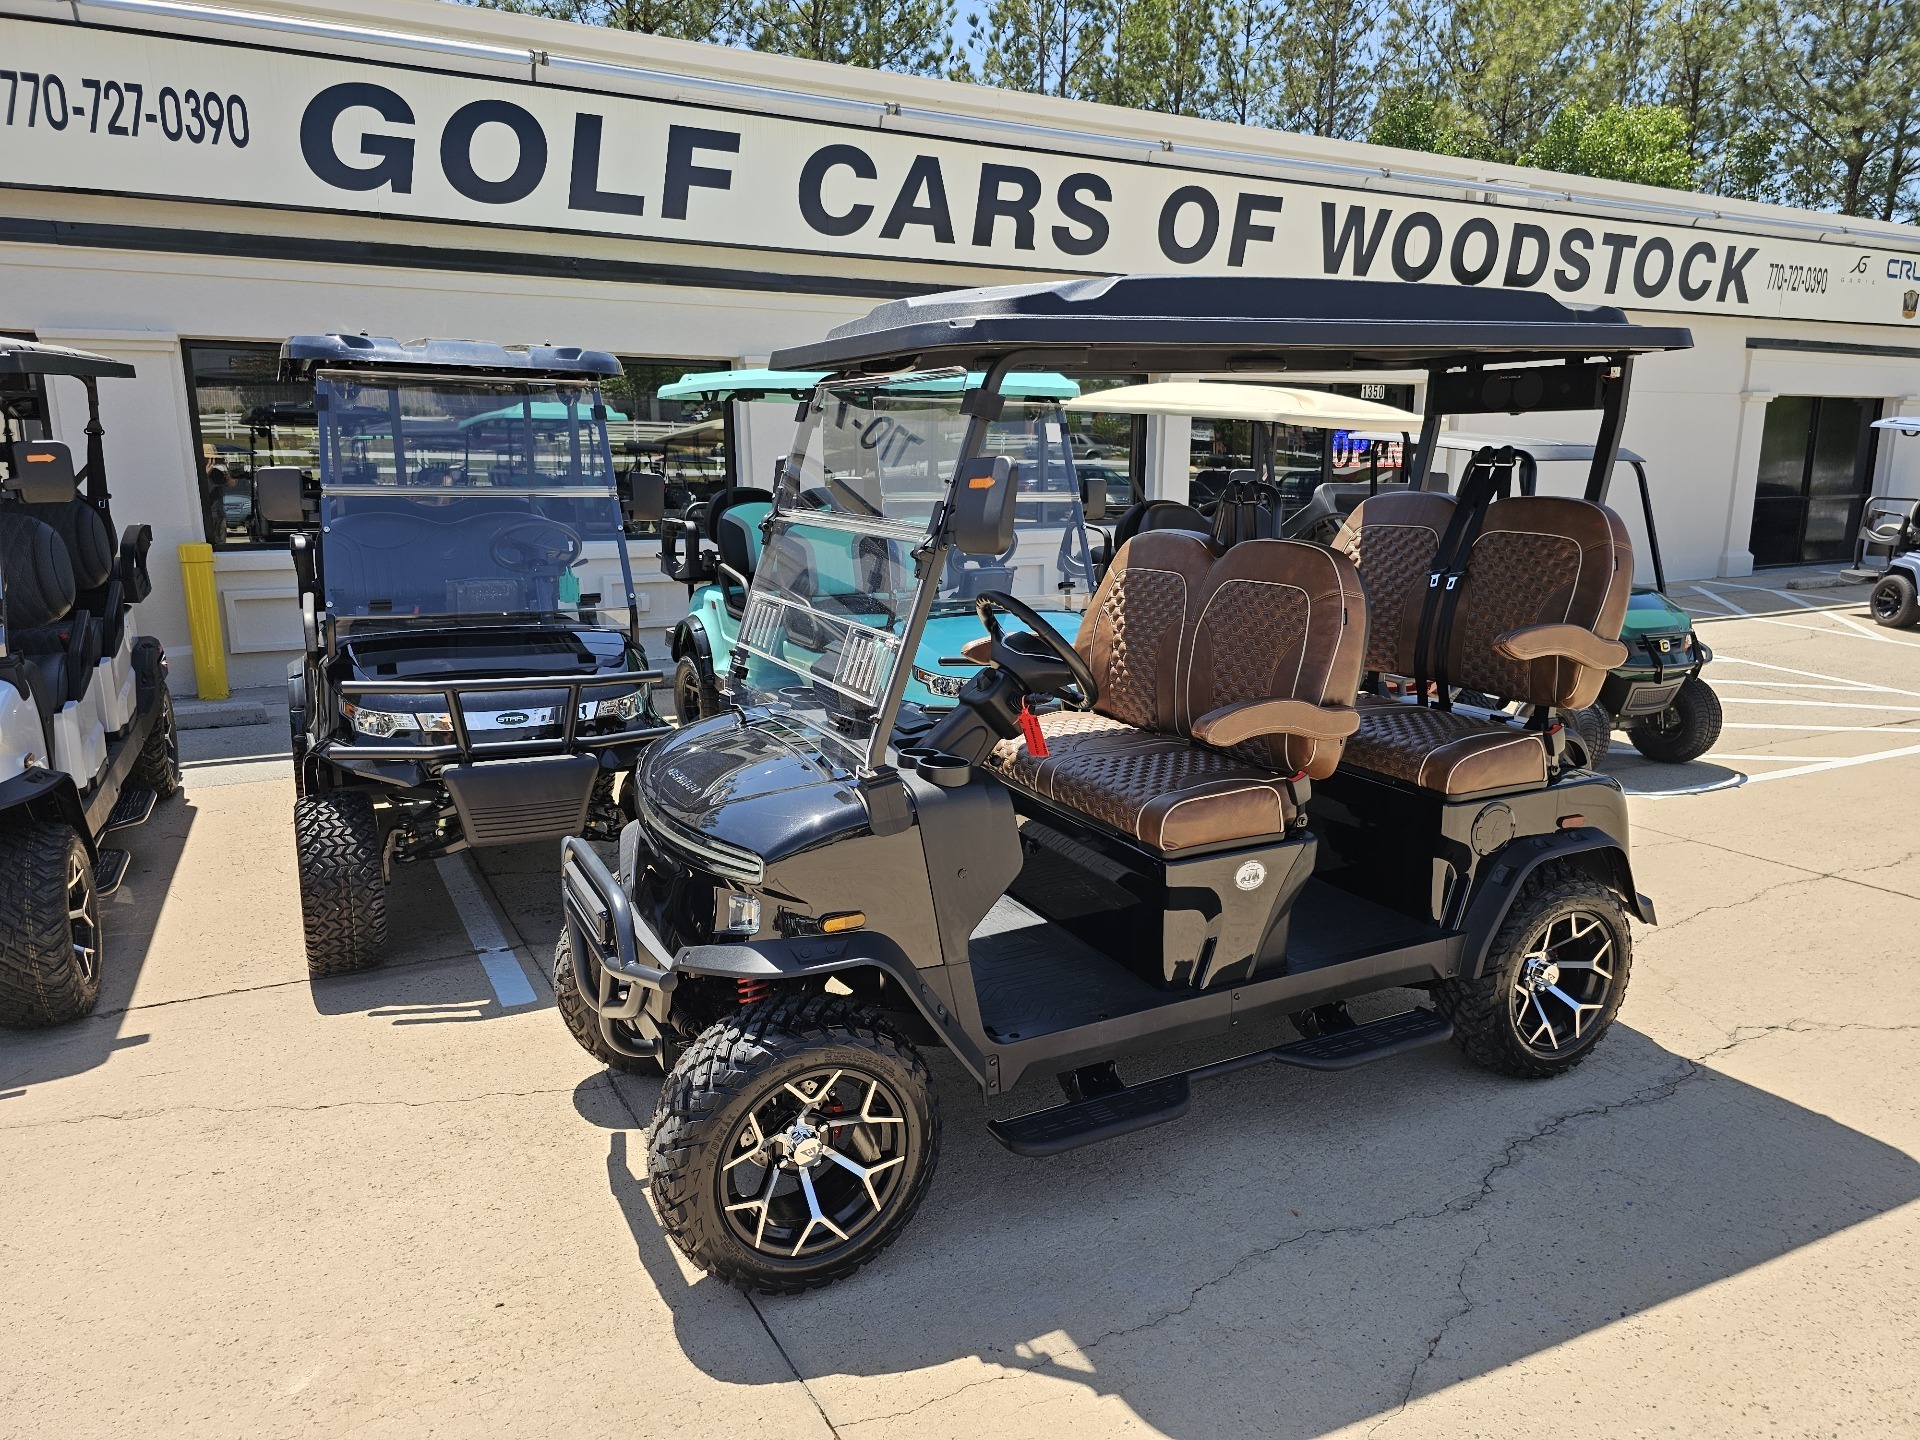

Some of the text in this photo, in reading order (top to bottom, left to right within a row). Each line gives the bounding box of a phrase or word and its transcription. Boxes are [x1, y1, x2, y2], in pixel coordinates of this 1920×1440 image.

[0, 69, 249, 149] 770-727-0390
[300, 81, 1760, 304] GOLF CARS OF WOODSTOCK
[1766, 263, 1828, 295] 770-727-0390
[1840, 277, 1875, 285] GARIA
[1362, 384, 1384, 399] 1350
